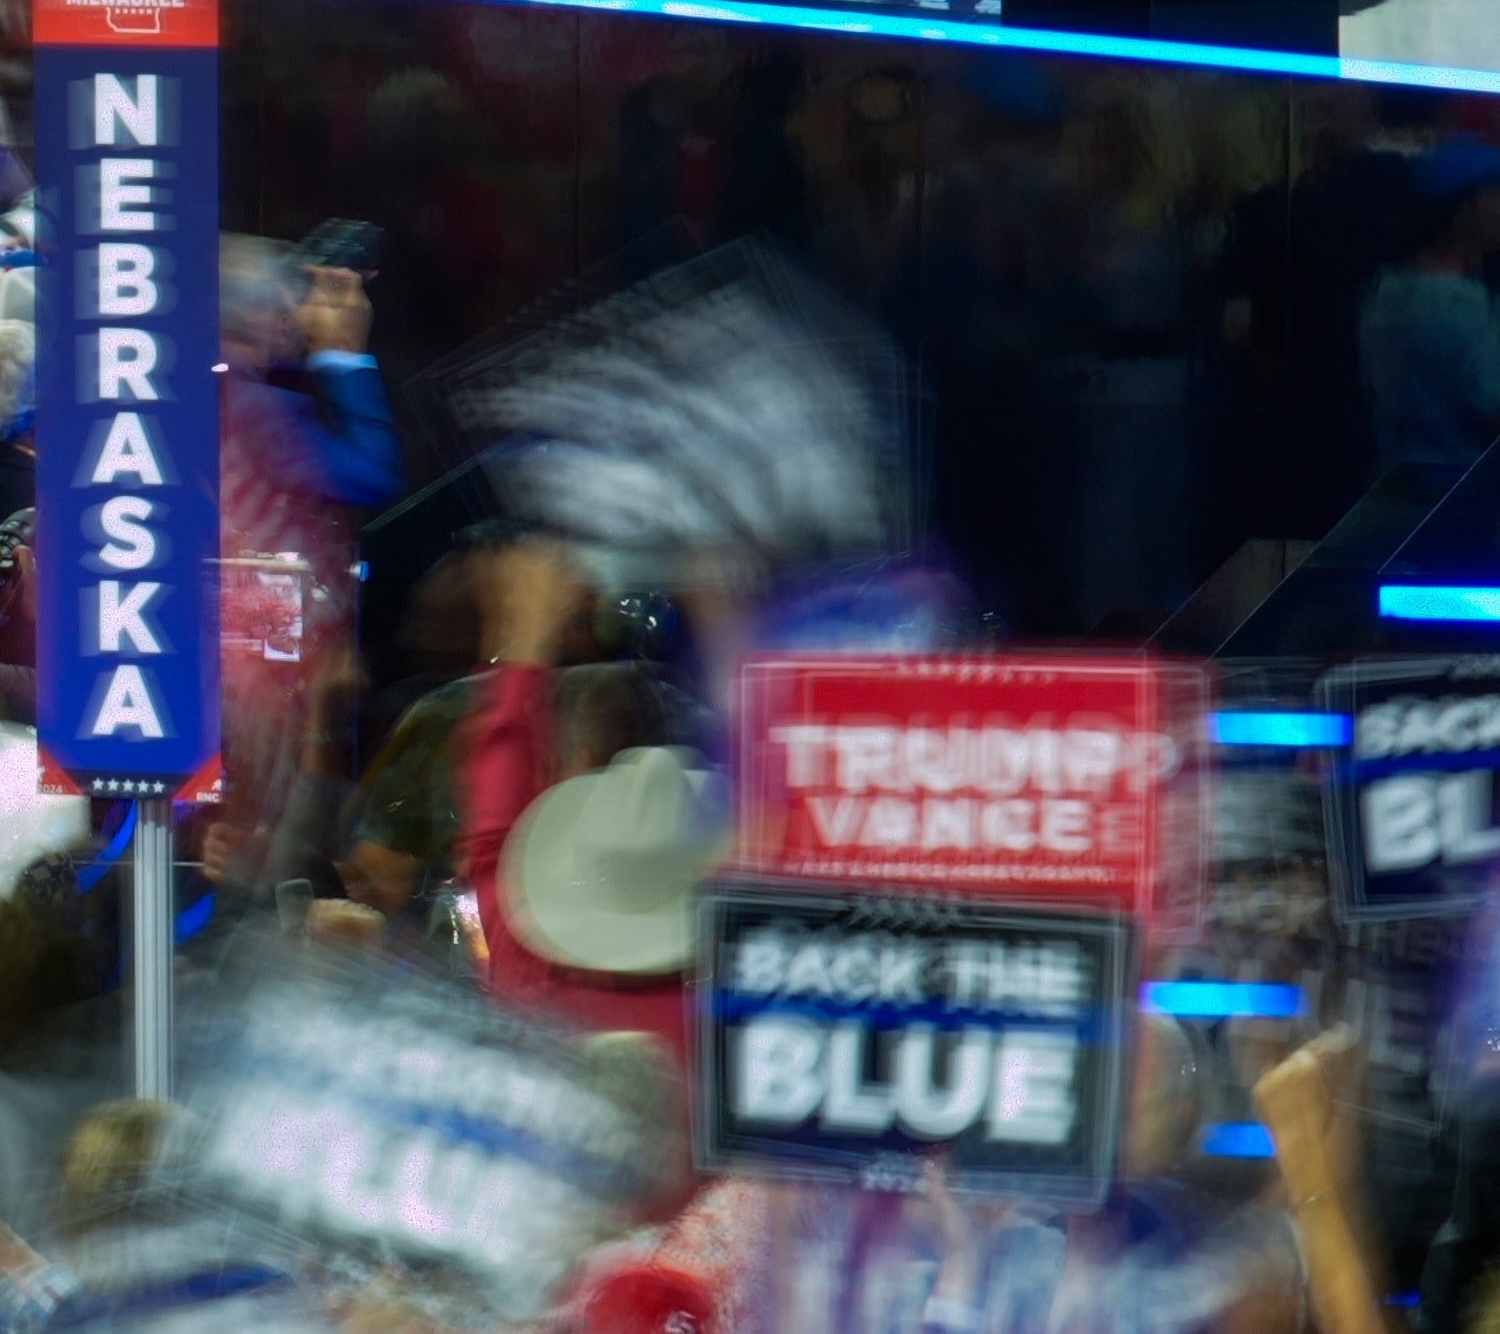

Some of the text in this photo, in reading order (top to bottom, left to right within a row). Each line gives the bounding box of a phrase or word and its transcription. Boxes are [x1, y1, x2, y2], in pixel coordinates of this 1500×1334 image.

[90, 72, 166, 740] NEBRASKA
[768, 717, 1150, 795] TRUMP
[805, 796, 1097, 853] VANCE
[1365, 774, 1500, 868] BL
[735, 935, 1084, 1007] BACK THE
[735, 1021, 1084, 1146] BLUE
